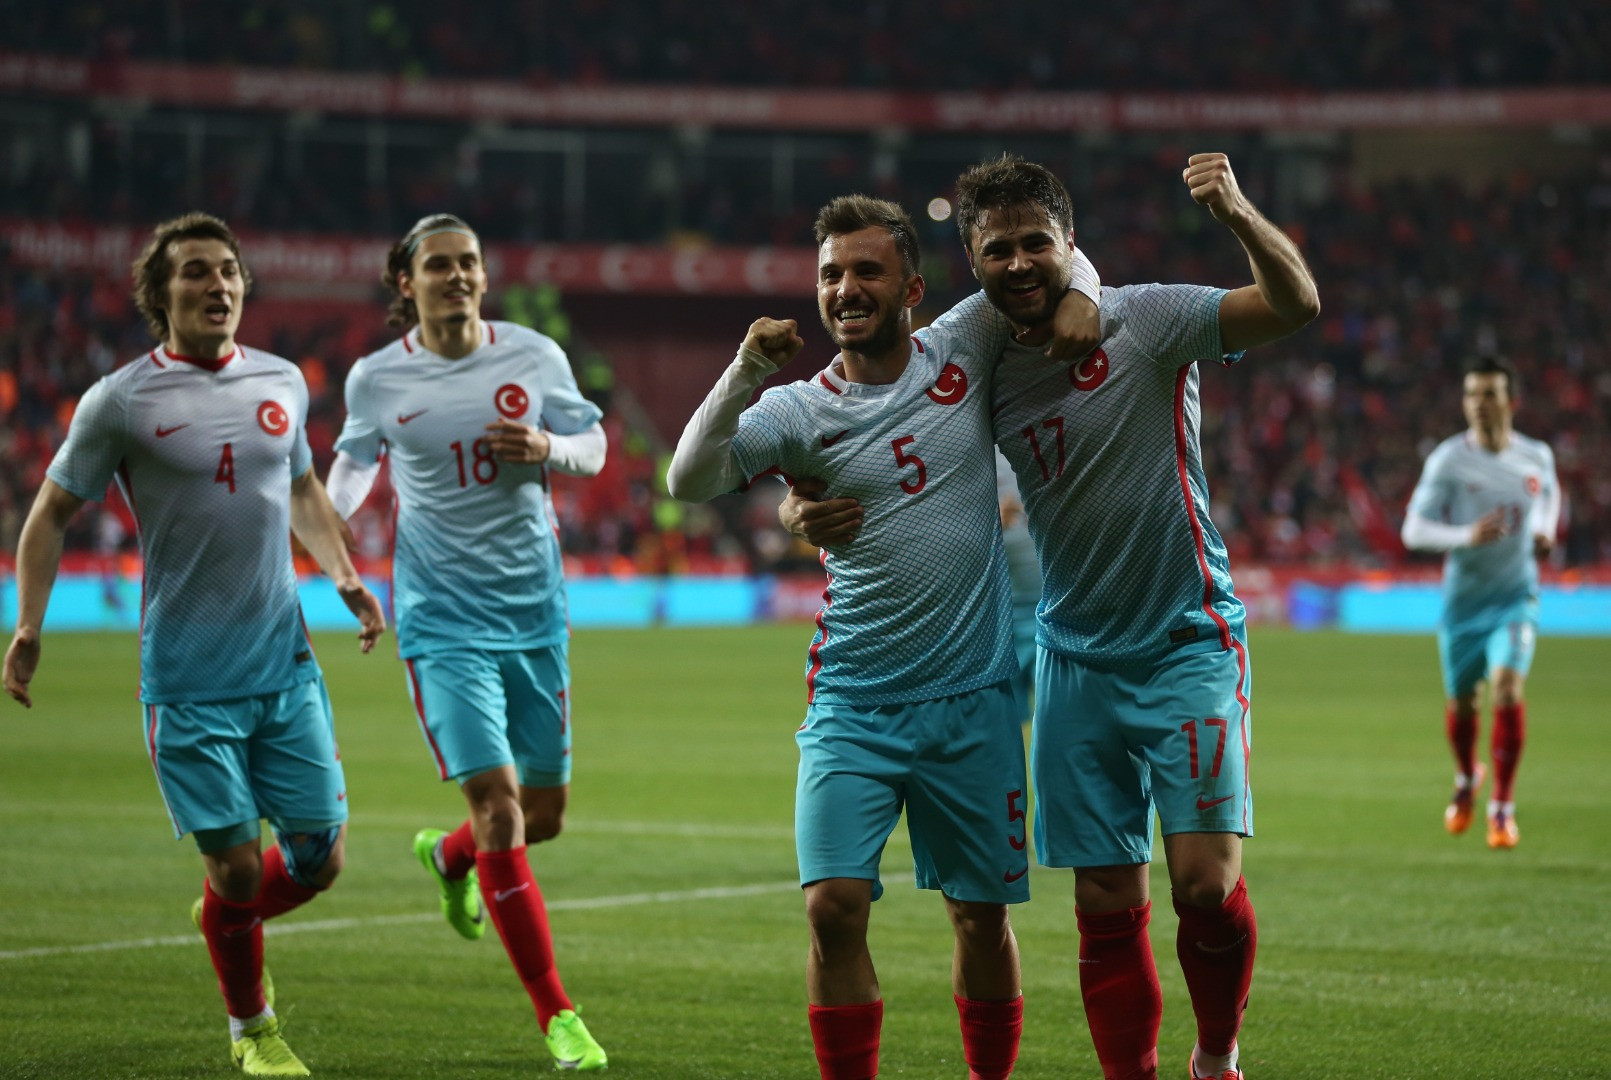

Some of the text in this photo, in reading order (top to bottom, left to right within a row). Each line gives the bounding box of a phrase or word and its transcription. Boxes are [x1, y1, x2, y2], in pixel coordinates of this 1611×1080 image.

[214, 442, 236, 494] 4
[449, 437, 499, 488] 18
[891, 435, 927, 495] 5
[1022, 416, 1065, 481] 17
[1181, 718, 1228, 779] 17
[1006, 789, 1026, 850] 5
